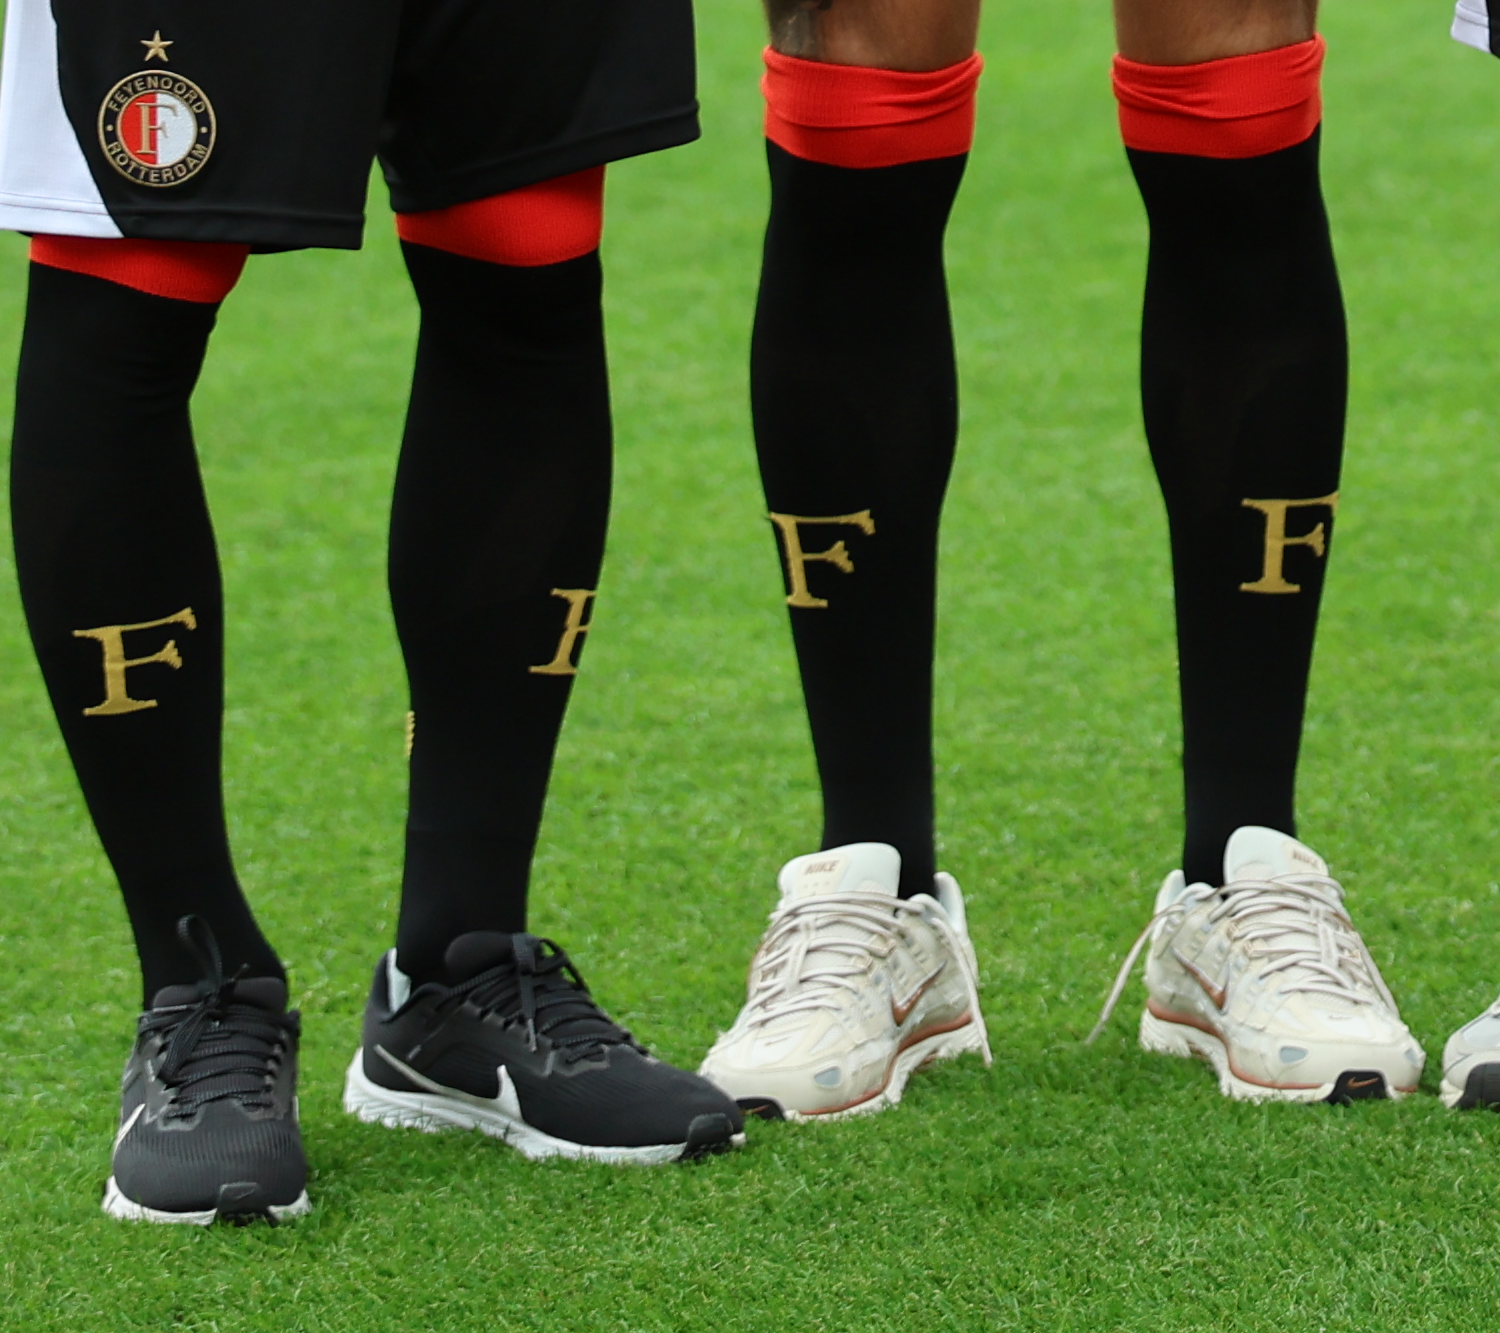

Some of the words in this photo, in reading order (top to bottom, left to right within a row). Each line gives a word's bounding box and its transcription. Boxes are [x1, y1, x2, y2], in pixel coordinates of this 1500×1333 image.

[108, 76, 206, 113] FEYENOORD
[136, 102, 178, 154] F
[107, 142, 208, 182] ROTTERDAM
[768, 510, 875, 608] F
[1239, 491, 1340, 594] F
[72, 606, 197, 717] F
